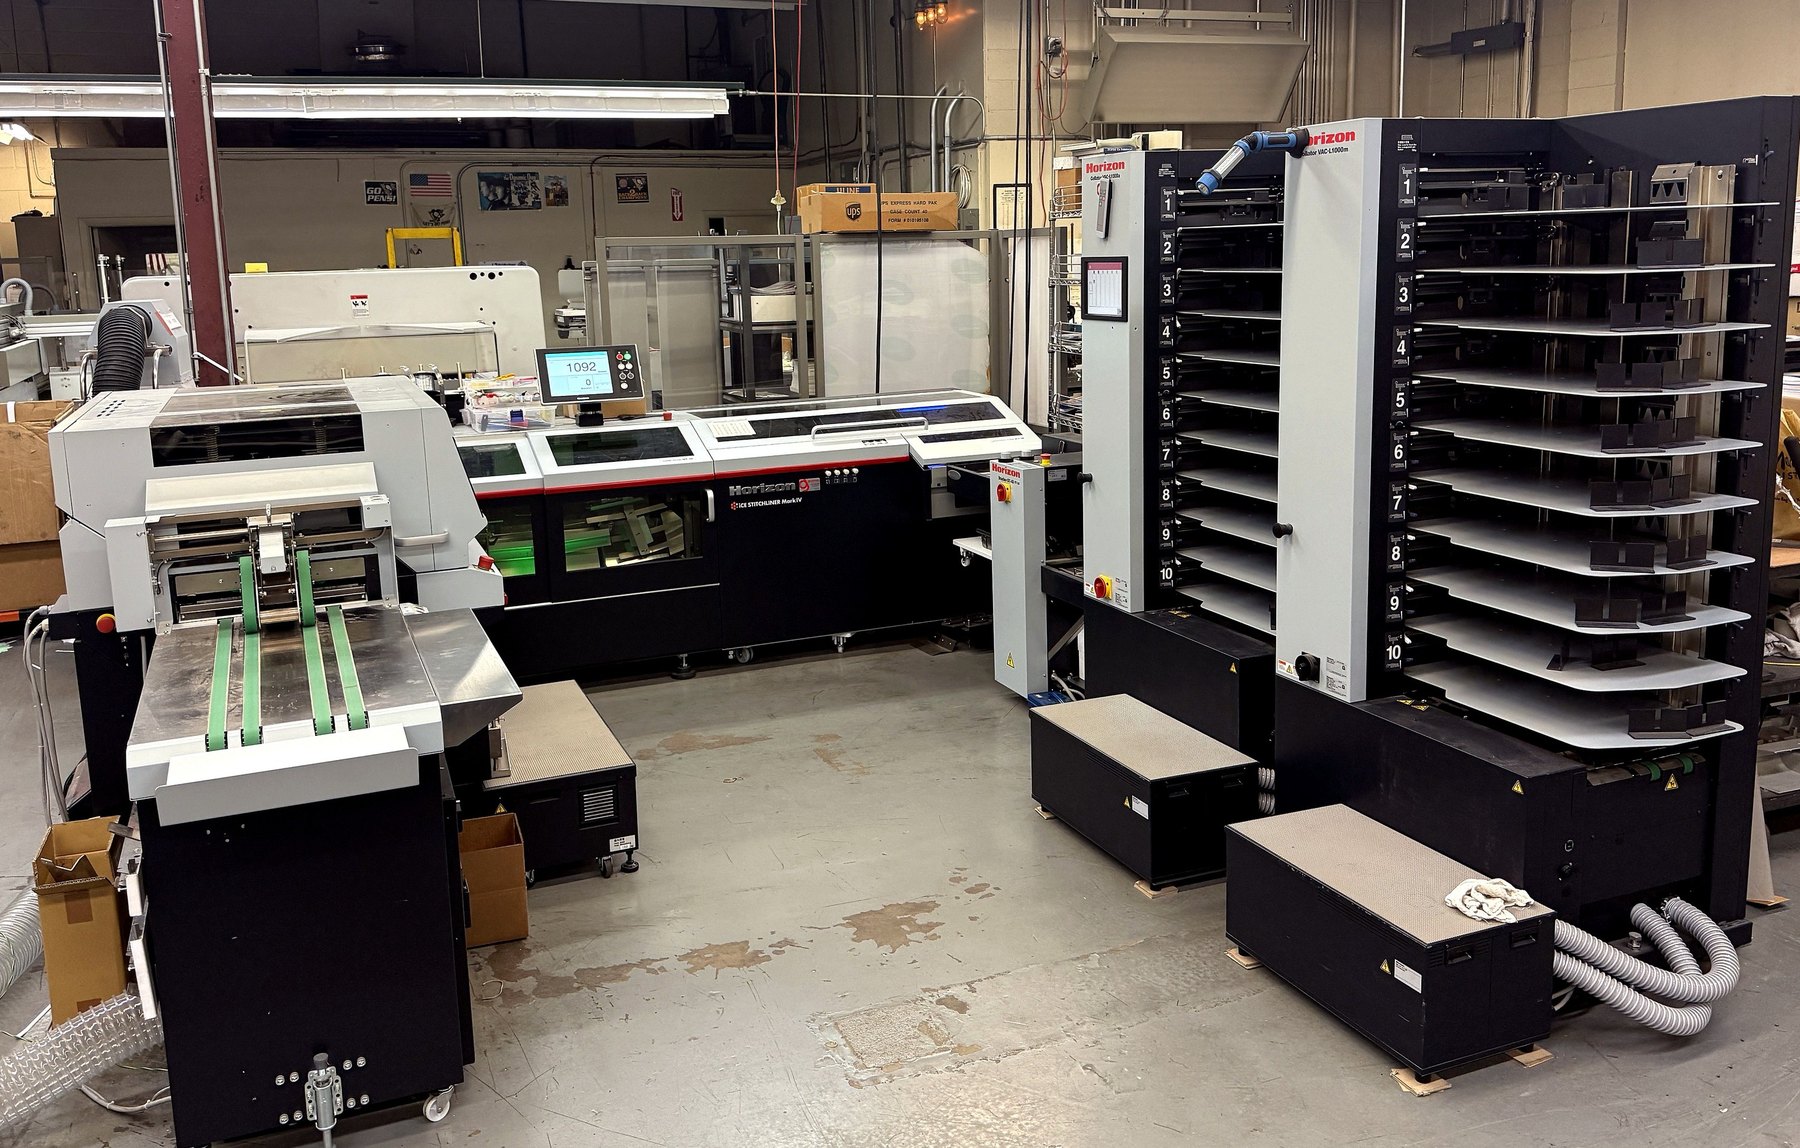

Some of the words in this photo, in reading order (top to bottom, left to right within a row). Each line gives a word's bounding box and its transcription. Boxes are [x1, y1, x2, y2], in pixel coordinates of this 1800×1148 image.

[1308, 131, 1356, 147] orizon
[1302, 149, 1317, 157] ollator
[1085, 161, 1125, 174] Horizon
[836, 186, 861, 194] ULINE
[1403, 178, 1410, 195] 1
[1164, 198, 1171, 212] 1
[847, 207, 861, 219] ups
[1163, 241, 1172, 255] 2
[1400, 233, 1411, 249] 2
[1163, 283, 1171, 297] 3
[1398, 286, 1409, 303] 3
[1162, 325, 1171, 338] 4
[1396, 339, 1406, 356] 4
[566, 361, 596, 373] 1092
[1162, 366, 1171, 380] 5
[585, 378, 592, 386] 0
[1395, 392, 1405, 408] 5
[1162, 407, 1171, 421] 6
[1162, 448, 1171, 461] 7
[1394, 444, 1404, 460] 6
[991, 463, 1021, 479] Horizon
[729, 482, 796, 496] Horizon
[1162, 488, 1170, 501] 8
[747, 499, 781, 508] STITCHLINER
[1392, 494, 1403, 511] 7
[1162, 528, 1170, 541] 9
[1391, 545, 1401, 561] 8
[1159, 567, 1173, 580] 10
[1390, 595, 1400, 611] 9
[1386, 644, 1401, 660] 10
